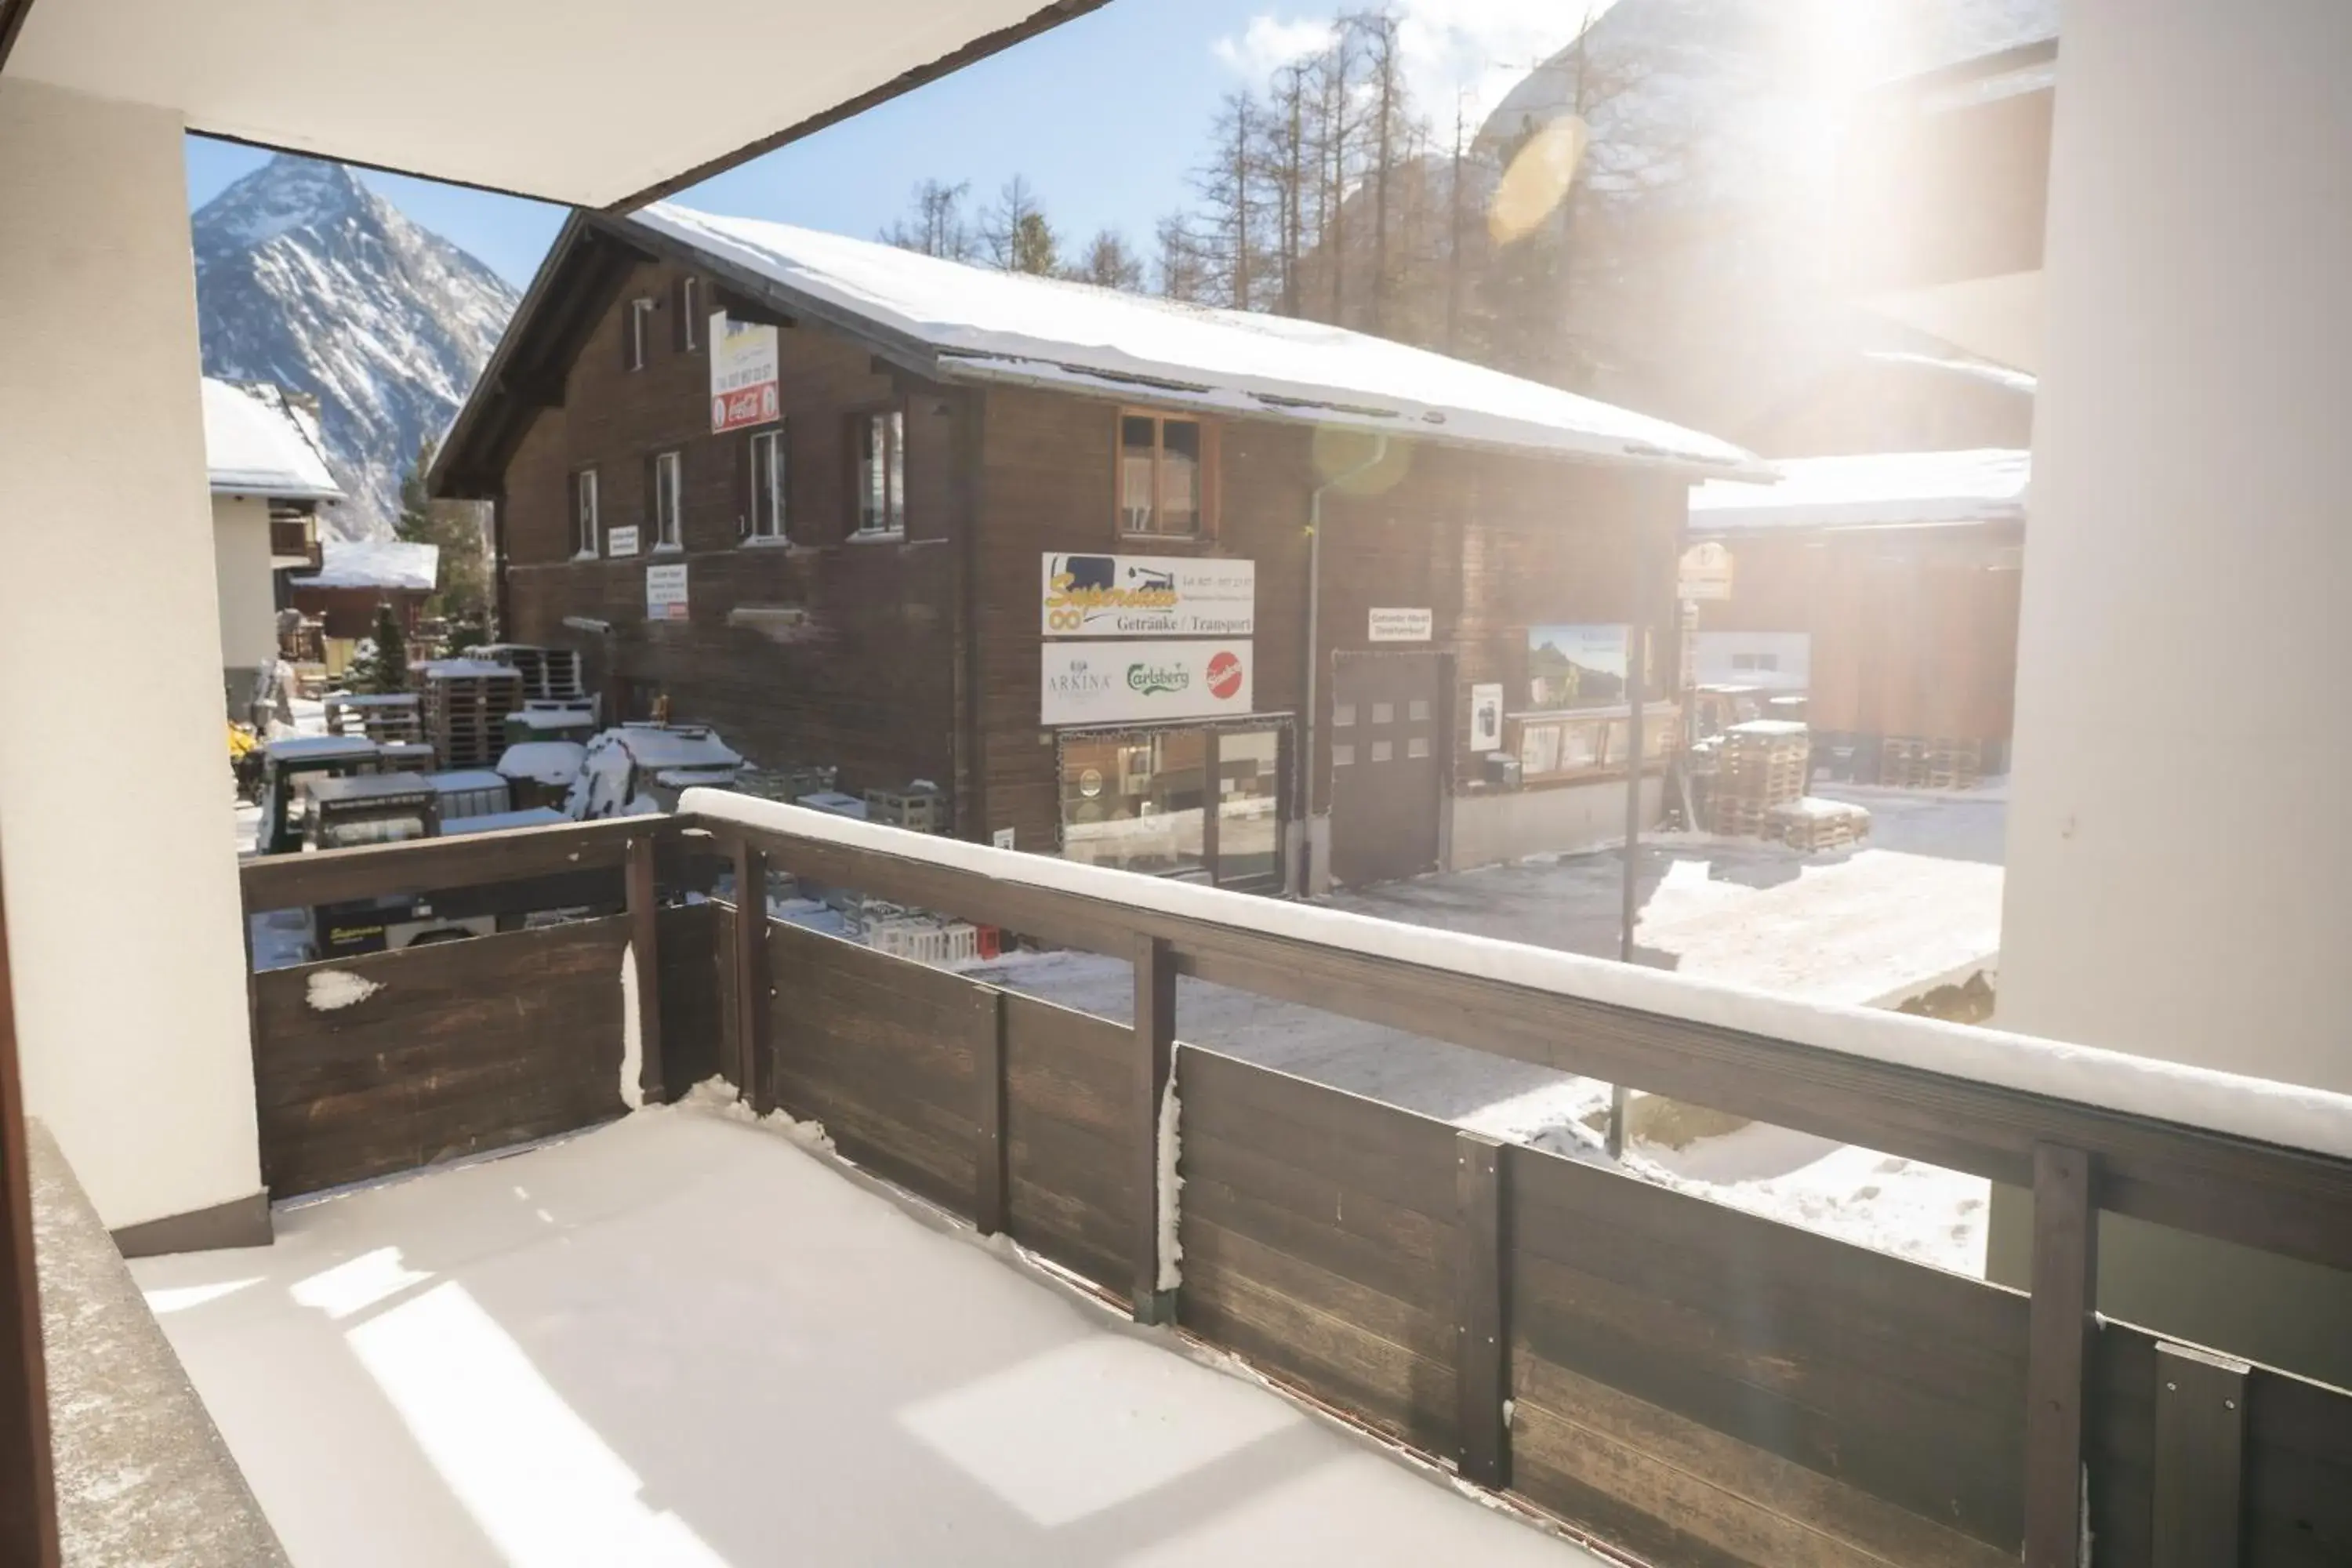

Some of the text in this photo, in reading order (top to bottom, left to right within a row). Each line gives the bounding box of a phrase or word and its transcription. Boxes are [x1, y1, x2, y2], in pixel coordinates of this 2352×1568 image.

[1117, 616, 1178, 630] Getränke
[1192, 616, 1251, 633] Transport
[1127, 662, 1189, 691] Carlsberg
